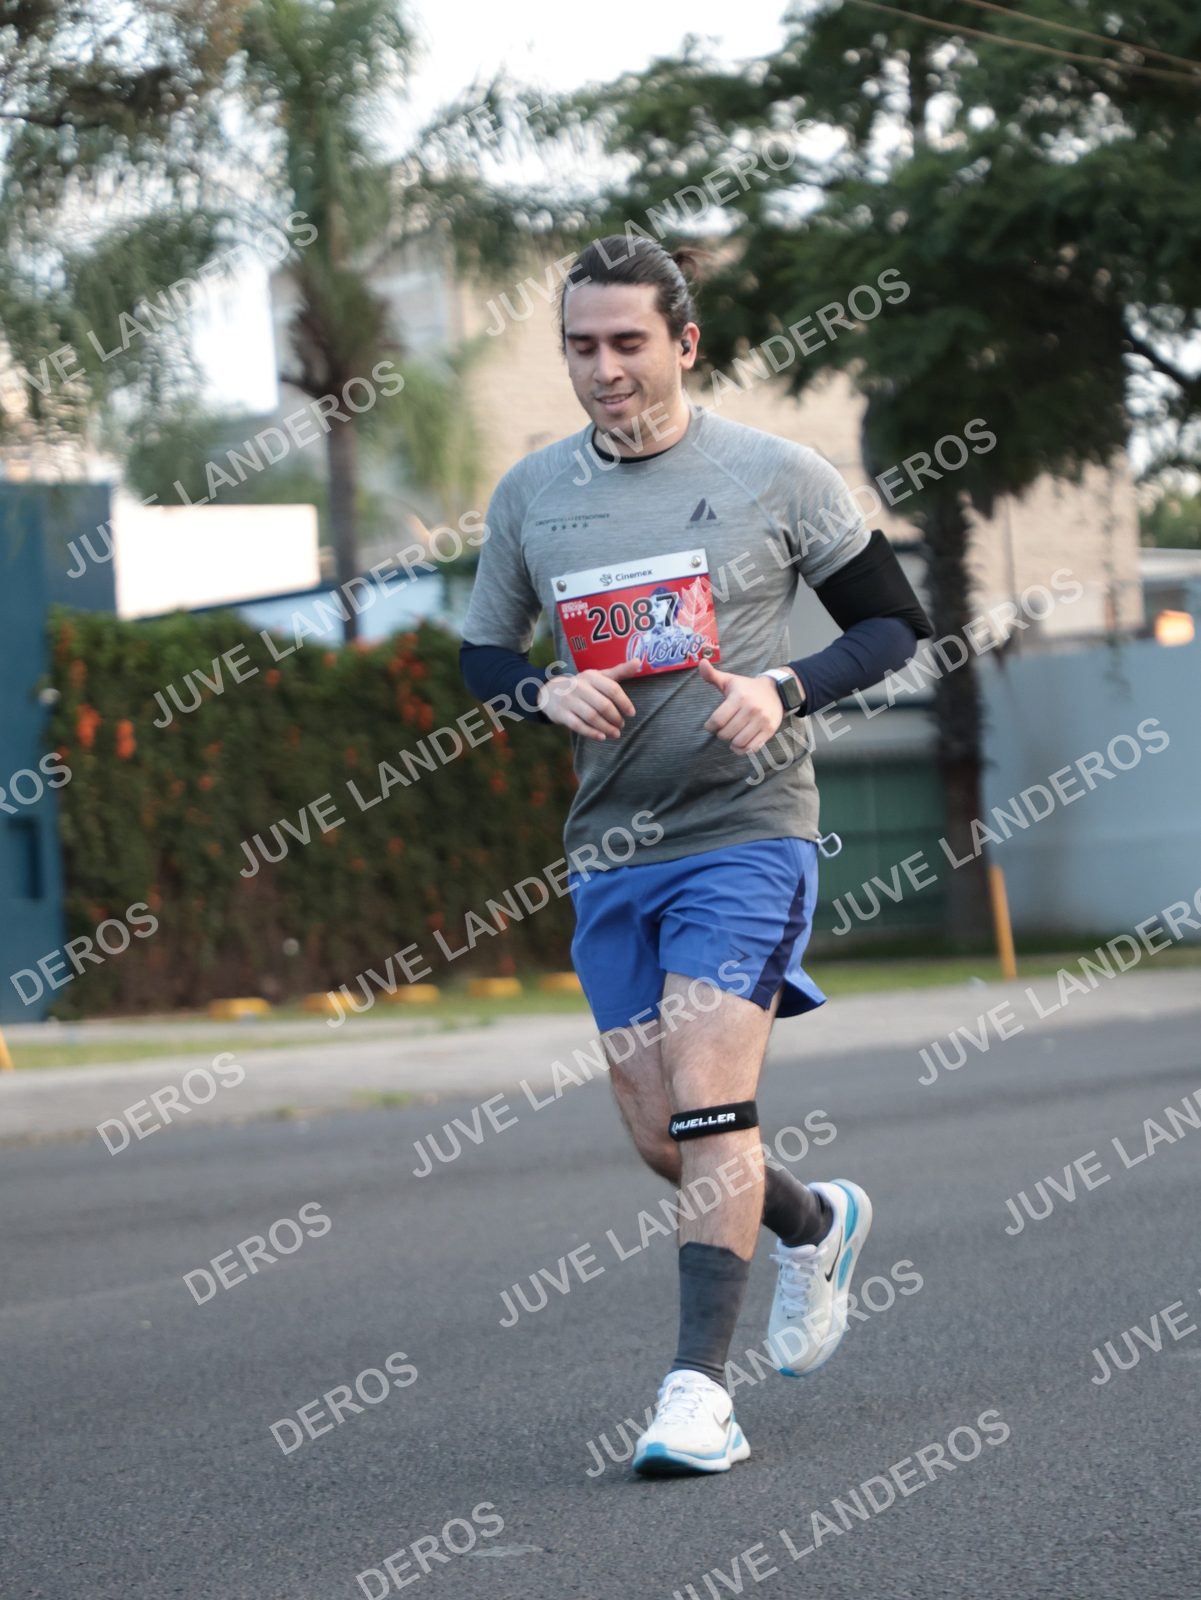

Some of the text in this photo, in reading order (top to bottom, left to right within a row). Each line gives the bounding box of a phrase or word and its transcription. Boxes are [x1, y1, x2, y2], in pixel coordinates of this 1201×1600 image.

[615, 569, 654, 581] Cinemex
[586, 590, 680, 643] 2087
[675, 1112, 736, 1131] MUELLER
